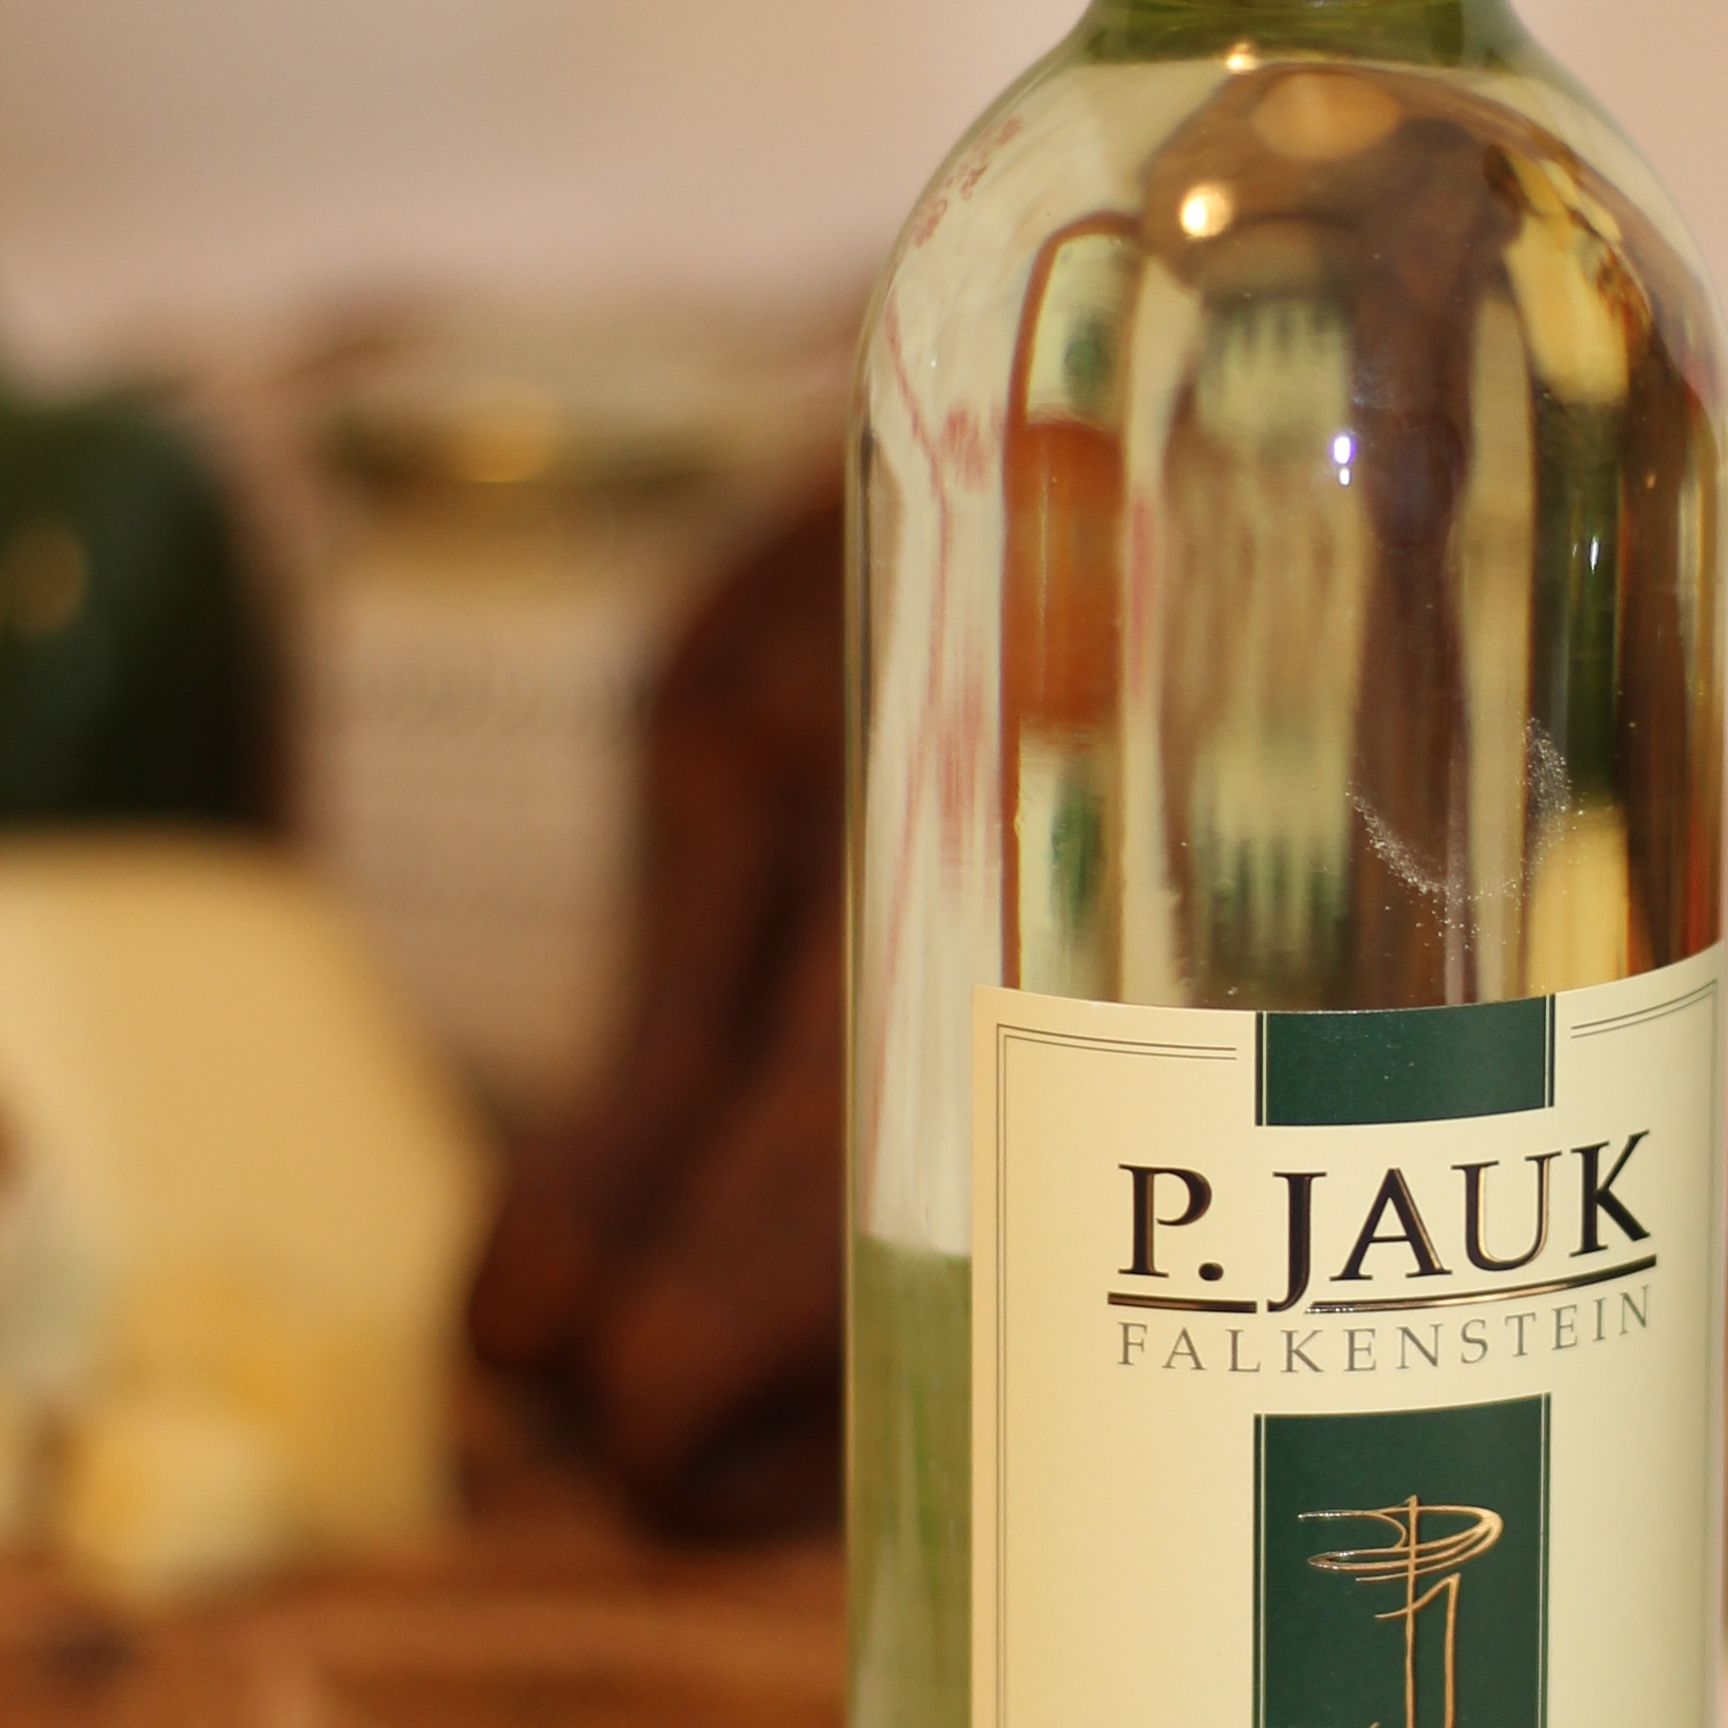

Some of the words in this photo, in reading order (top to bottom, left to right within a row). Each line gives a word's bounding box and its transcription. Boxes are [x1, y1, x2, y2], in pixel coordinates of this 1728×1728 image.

[1117, 1162, 1225, 1281] P.
[1266, 1128, 1652, 1313] JAUK
[1116, 1284, 1652, 1374] FALKENSTEIN
